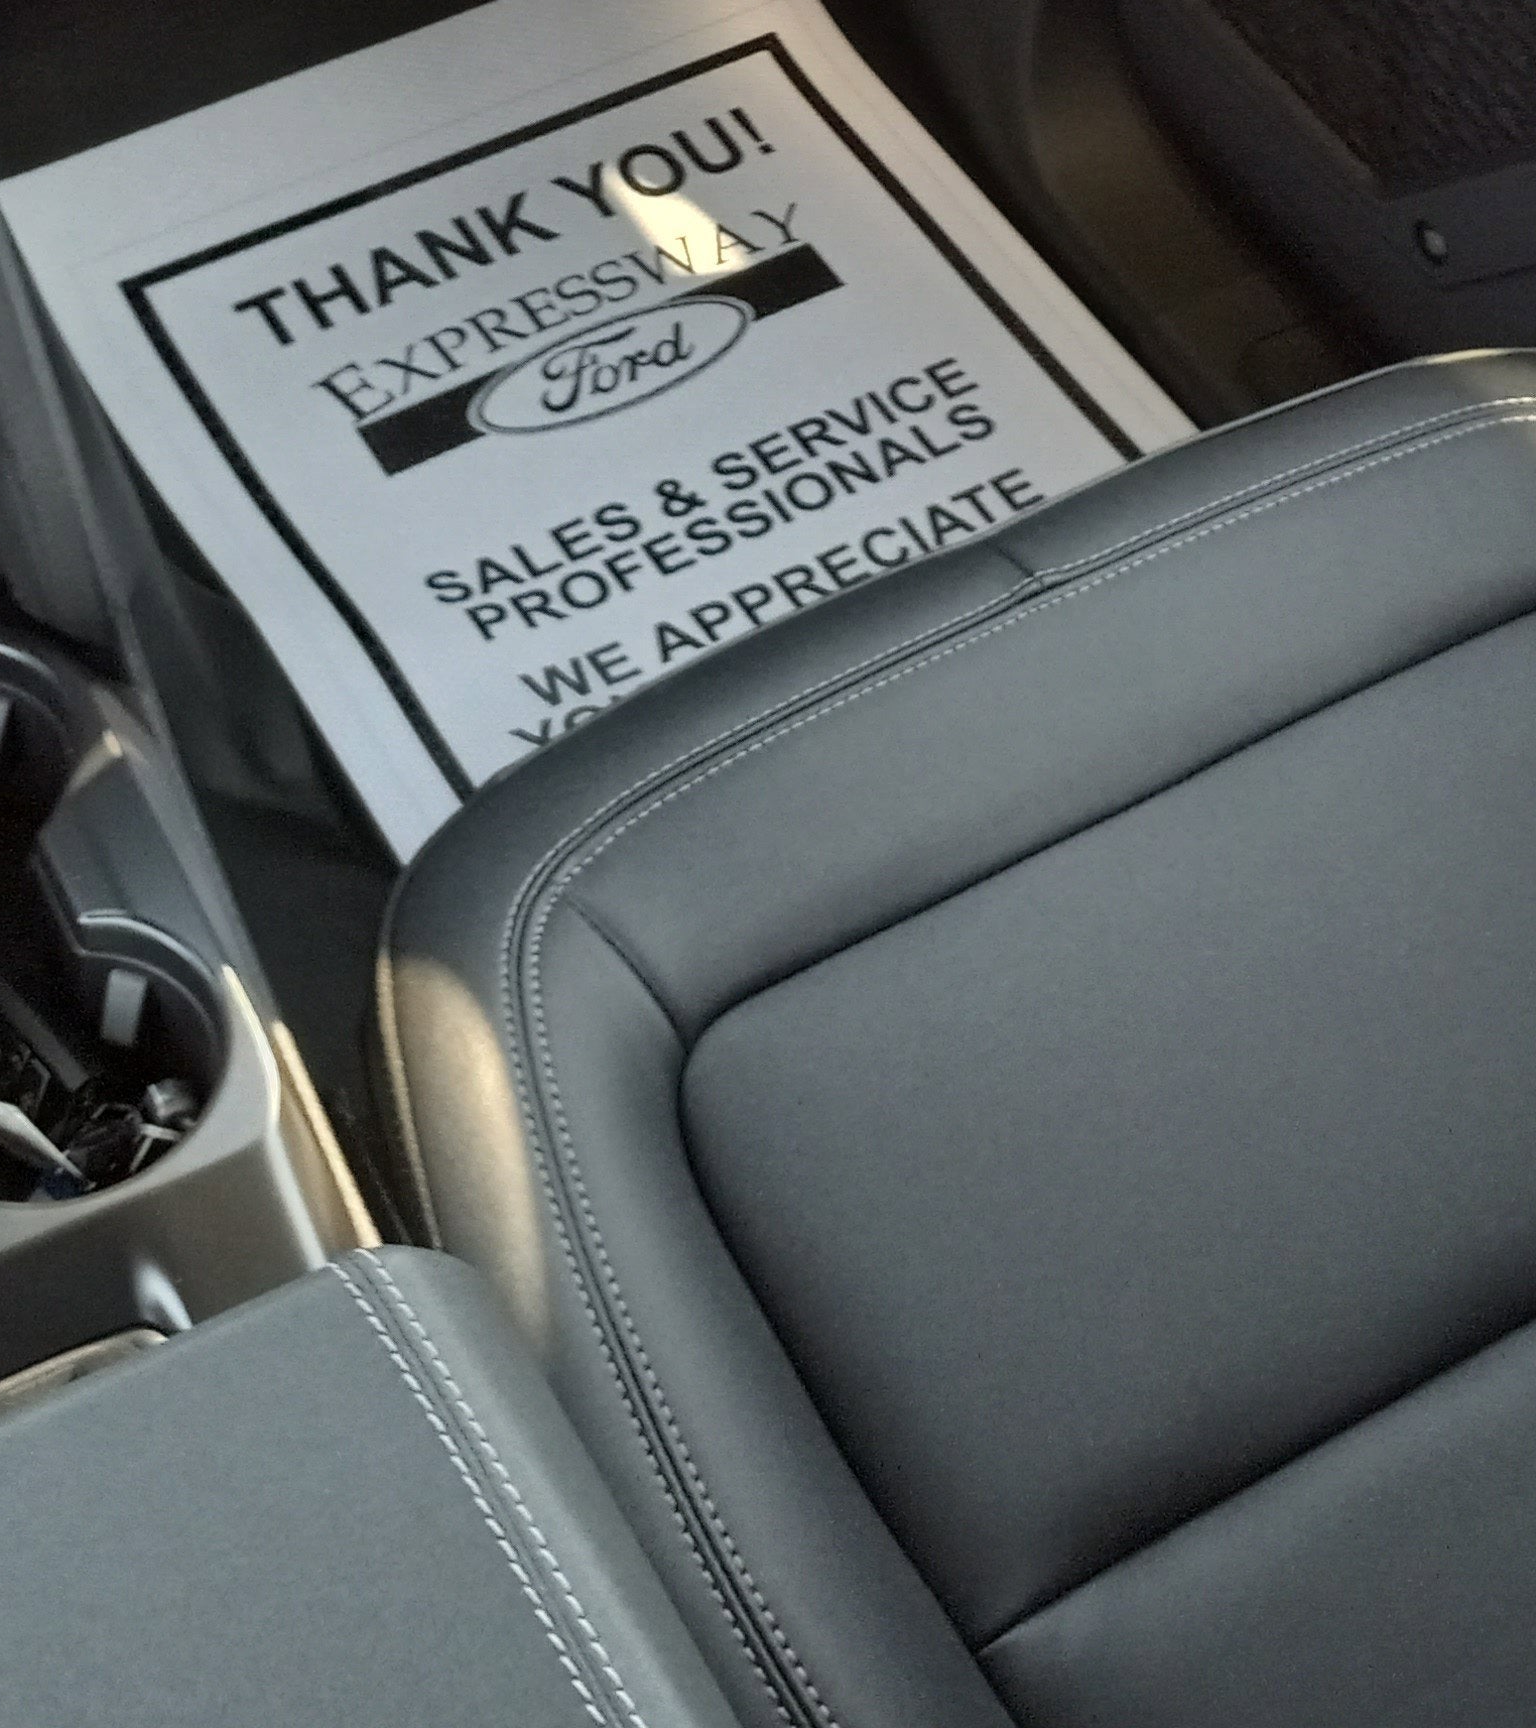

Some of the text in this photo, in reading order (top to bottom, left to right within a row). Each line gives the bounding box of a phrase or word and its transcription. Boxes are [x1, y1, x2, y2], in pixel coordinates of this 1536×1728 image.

[233, 107, 777, 347] THANK YOU!
[309, 202, 801, 420] EXPRESSWAY
[424, 356, 979, 603] SALES & SERVICE
[540, 323, 694, 412] Ford
[464, 403, 996, 641] PROFESSIONALS
[519, 468, 1044, 707] WE APPRECIATE
